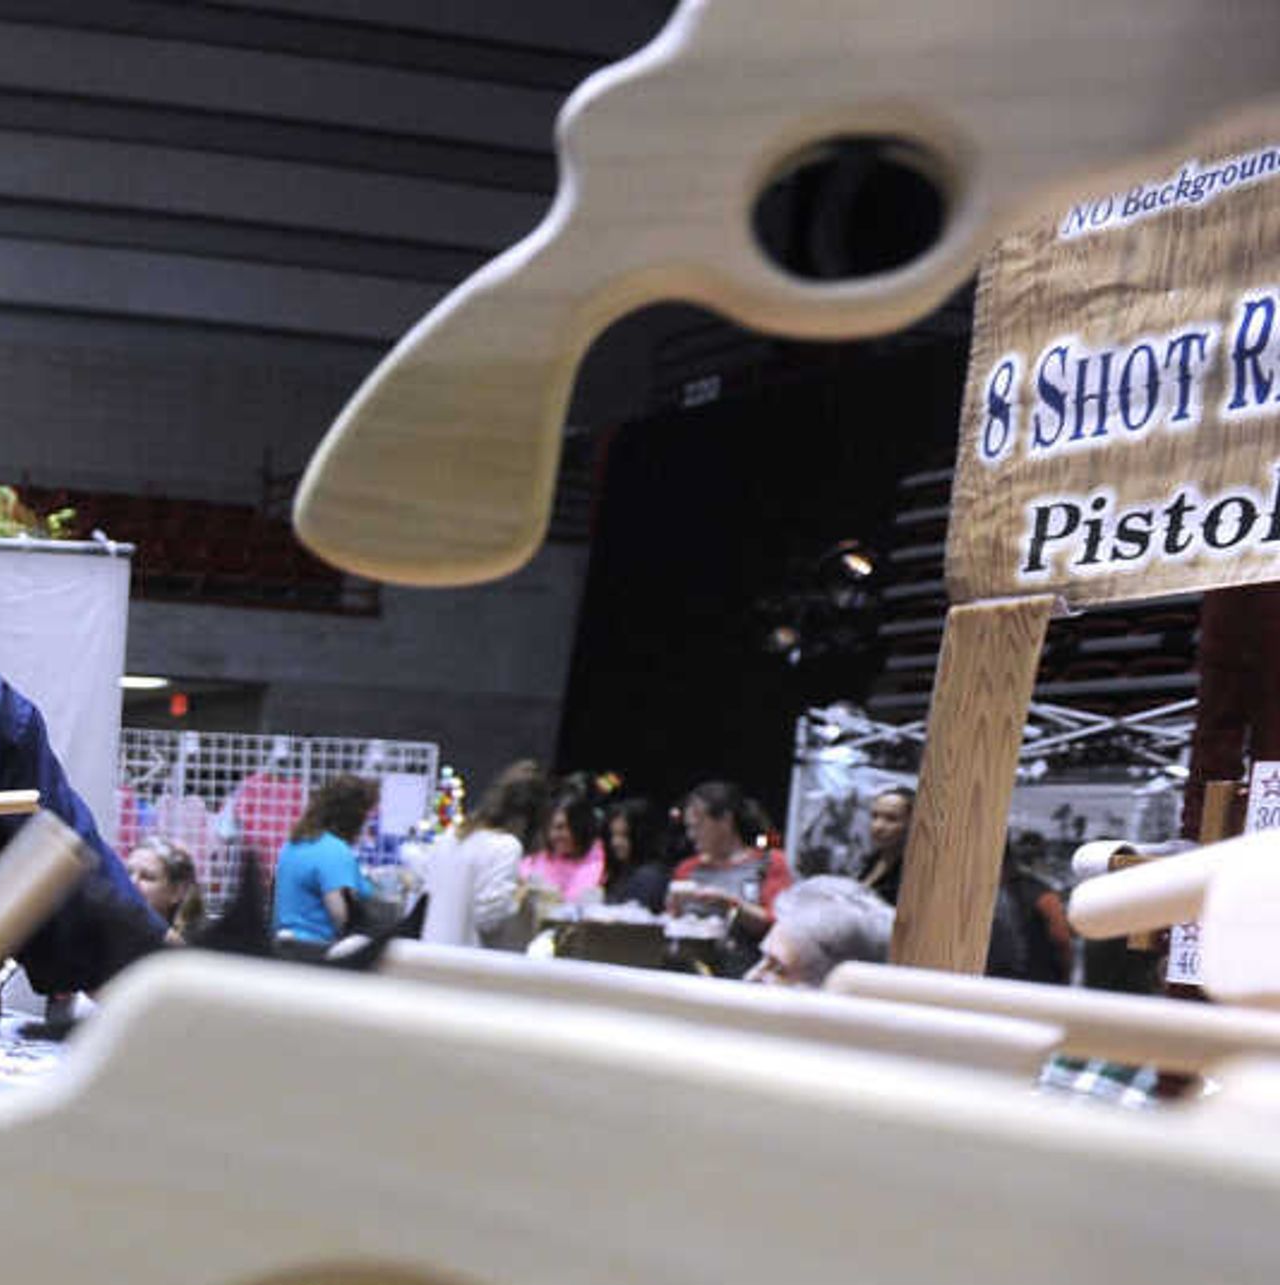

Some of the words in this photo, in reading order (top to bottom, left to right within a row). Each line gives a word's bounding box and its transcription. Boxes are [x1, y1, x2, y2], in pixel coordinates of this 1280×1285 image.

[1062, 197, 1114, 235] NO
[1121, 151, 1280, 218] Backgroun
[983, 361, 1016, 458] 8
[1032, 333, 1210, 449] SHOT
[1228, 296, 1280, 411] R
